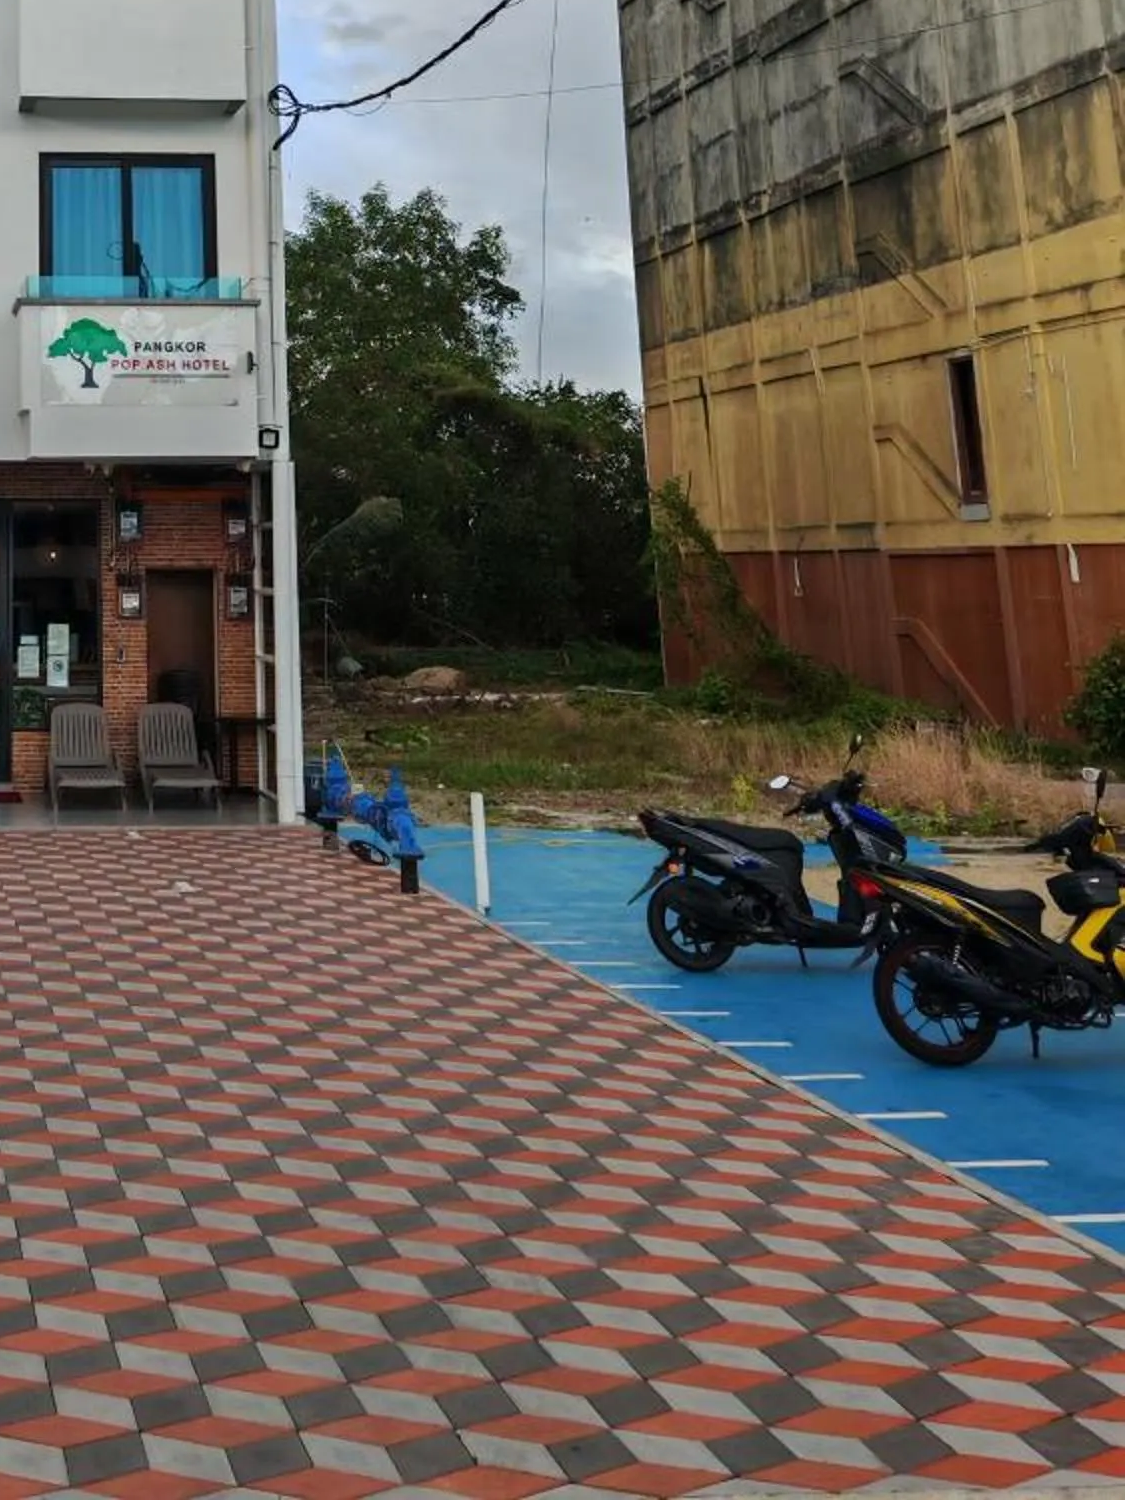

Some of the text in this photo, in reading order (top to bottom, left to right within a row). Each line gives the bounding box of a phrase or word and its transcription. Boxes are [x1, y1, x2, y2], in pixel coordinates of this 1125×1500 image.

[134, 341, 206, 352] PANGKOR
[111, 359, 230, 371] POP ASH HOTEL
